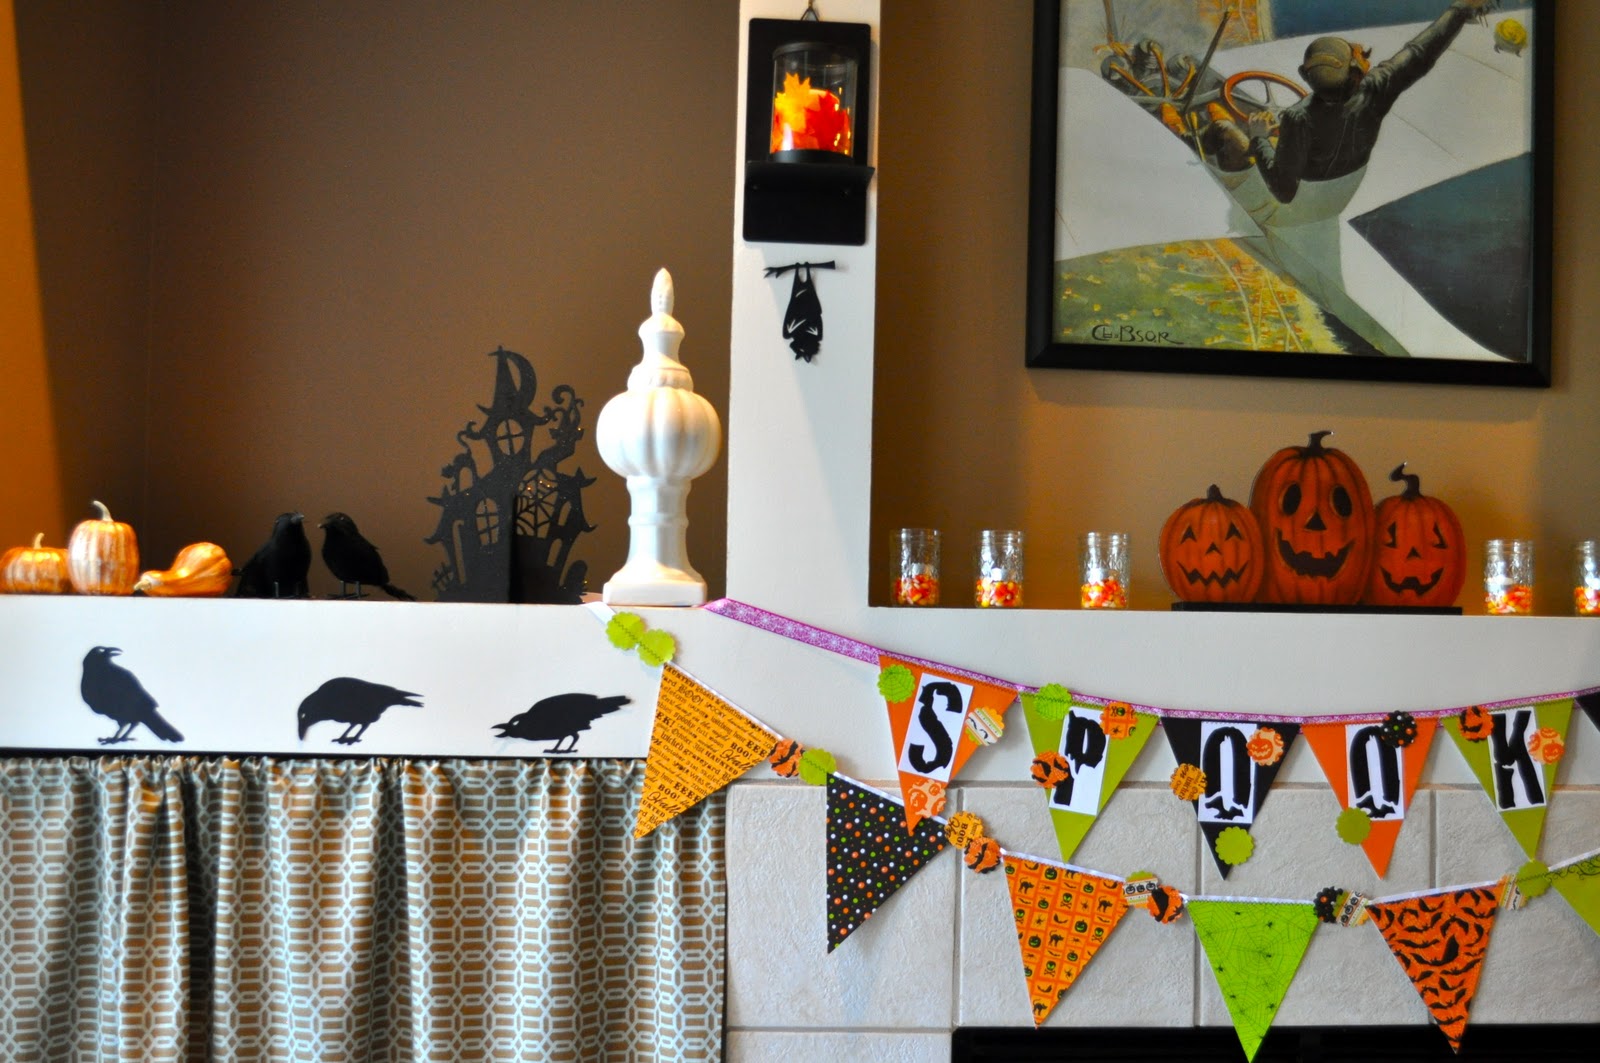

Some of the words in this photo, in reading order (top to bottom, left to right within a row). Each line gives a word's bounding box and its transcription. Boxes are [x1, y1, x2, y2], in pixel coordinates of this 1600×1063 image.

[729, 742, 752, 759] BOO!
[745, 740, 767, 758] EEE
[682, 747, 721, 775] graveyard
[704, 750, 738, 775] HAUNTED
[657, 783, 680, 802] BOO!
